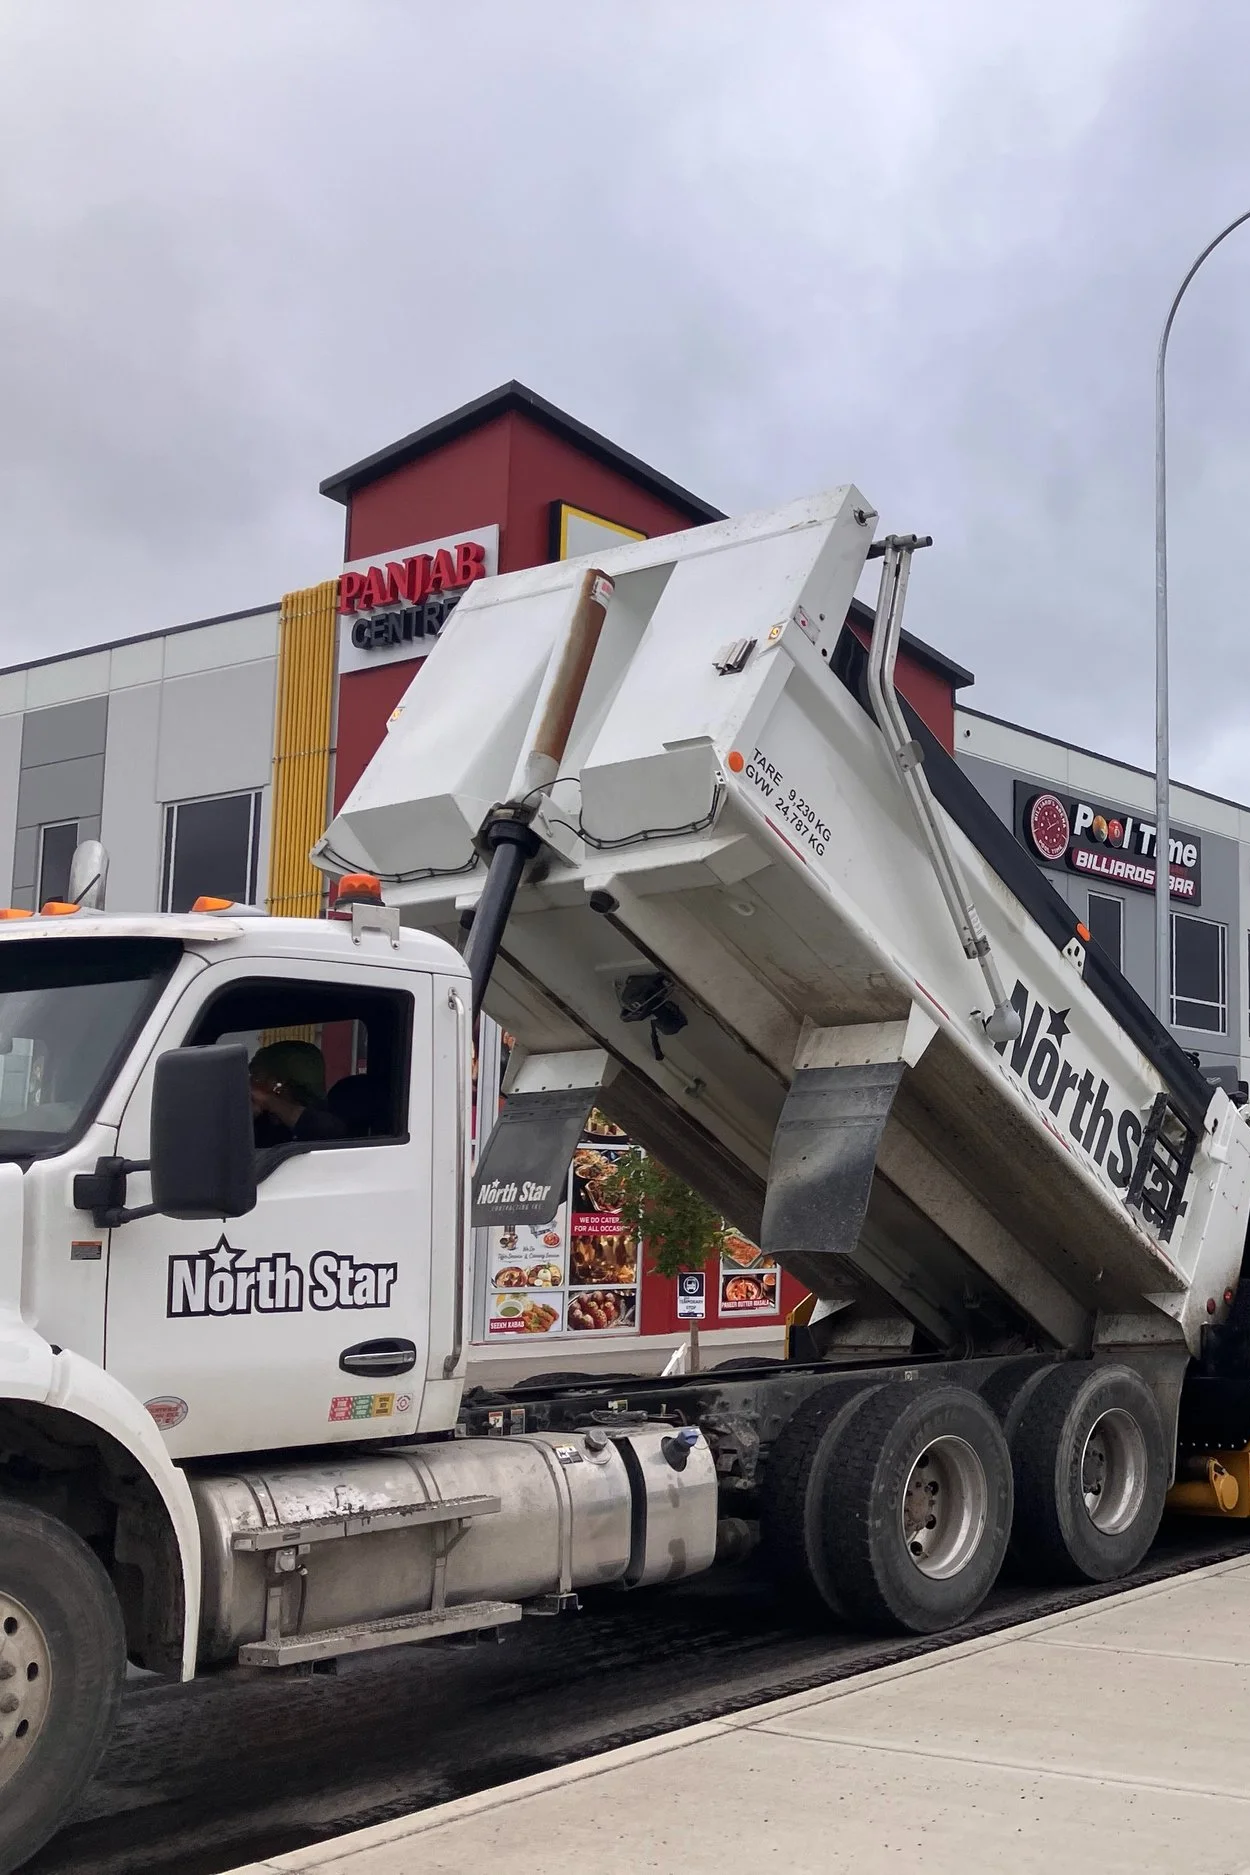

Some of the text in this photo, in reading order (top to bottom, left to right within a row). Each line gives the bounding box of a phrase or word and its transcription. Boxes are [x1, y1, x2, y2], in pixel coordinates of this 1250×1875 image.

[338, 541, 486, 616] PANJAB
[745, 764, 826, 857] GVW 24,787 KG
[753, 748, 832, 842] TARE 9,230 KG
[1075, 850, 1156, 885] BILLIARDS
[1138, 823, 1197, 868] Tme
[994, 979, 1114, 1167] North
[476, 1181, 552, 1205] North Star
[600, 1216, 621, 1224] CATER
[168, 1251, 397, 1316] North Star
[490, 1321, 507, 1329] SEEKH
